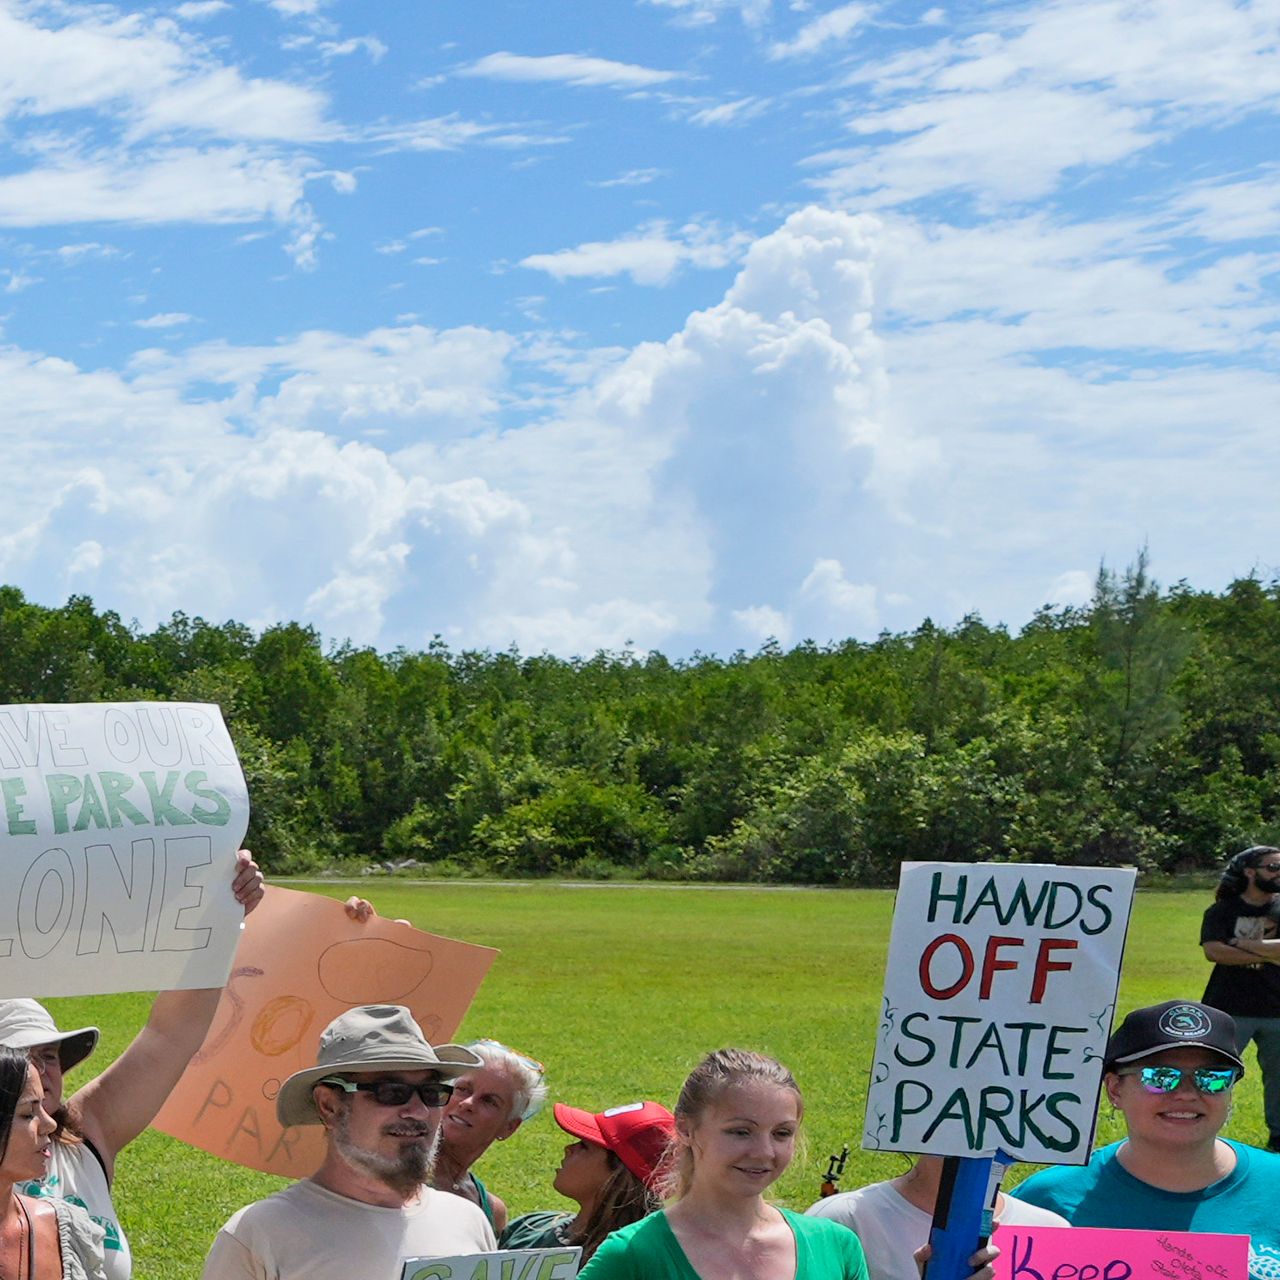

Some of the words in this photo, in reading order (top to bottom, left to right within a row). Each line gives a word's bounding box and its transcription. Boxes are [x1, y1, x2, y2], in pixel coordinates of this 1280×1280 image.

[102, 706, 236, 768] OUR
[45, 769, 232, 835] PARKS
[926, 871, 1114, 936] HANDS
[918, 932, 1080, 1004] OFF
[893, 1012, 1090, 1081] STATE
[194, 1080, 303, 1163] PAR
[889, 1079, 1083, 1153] PARKS
